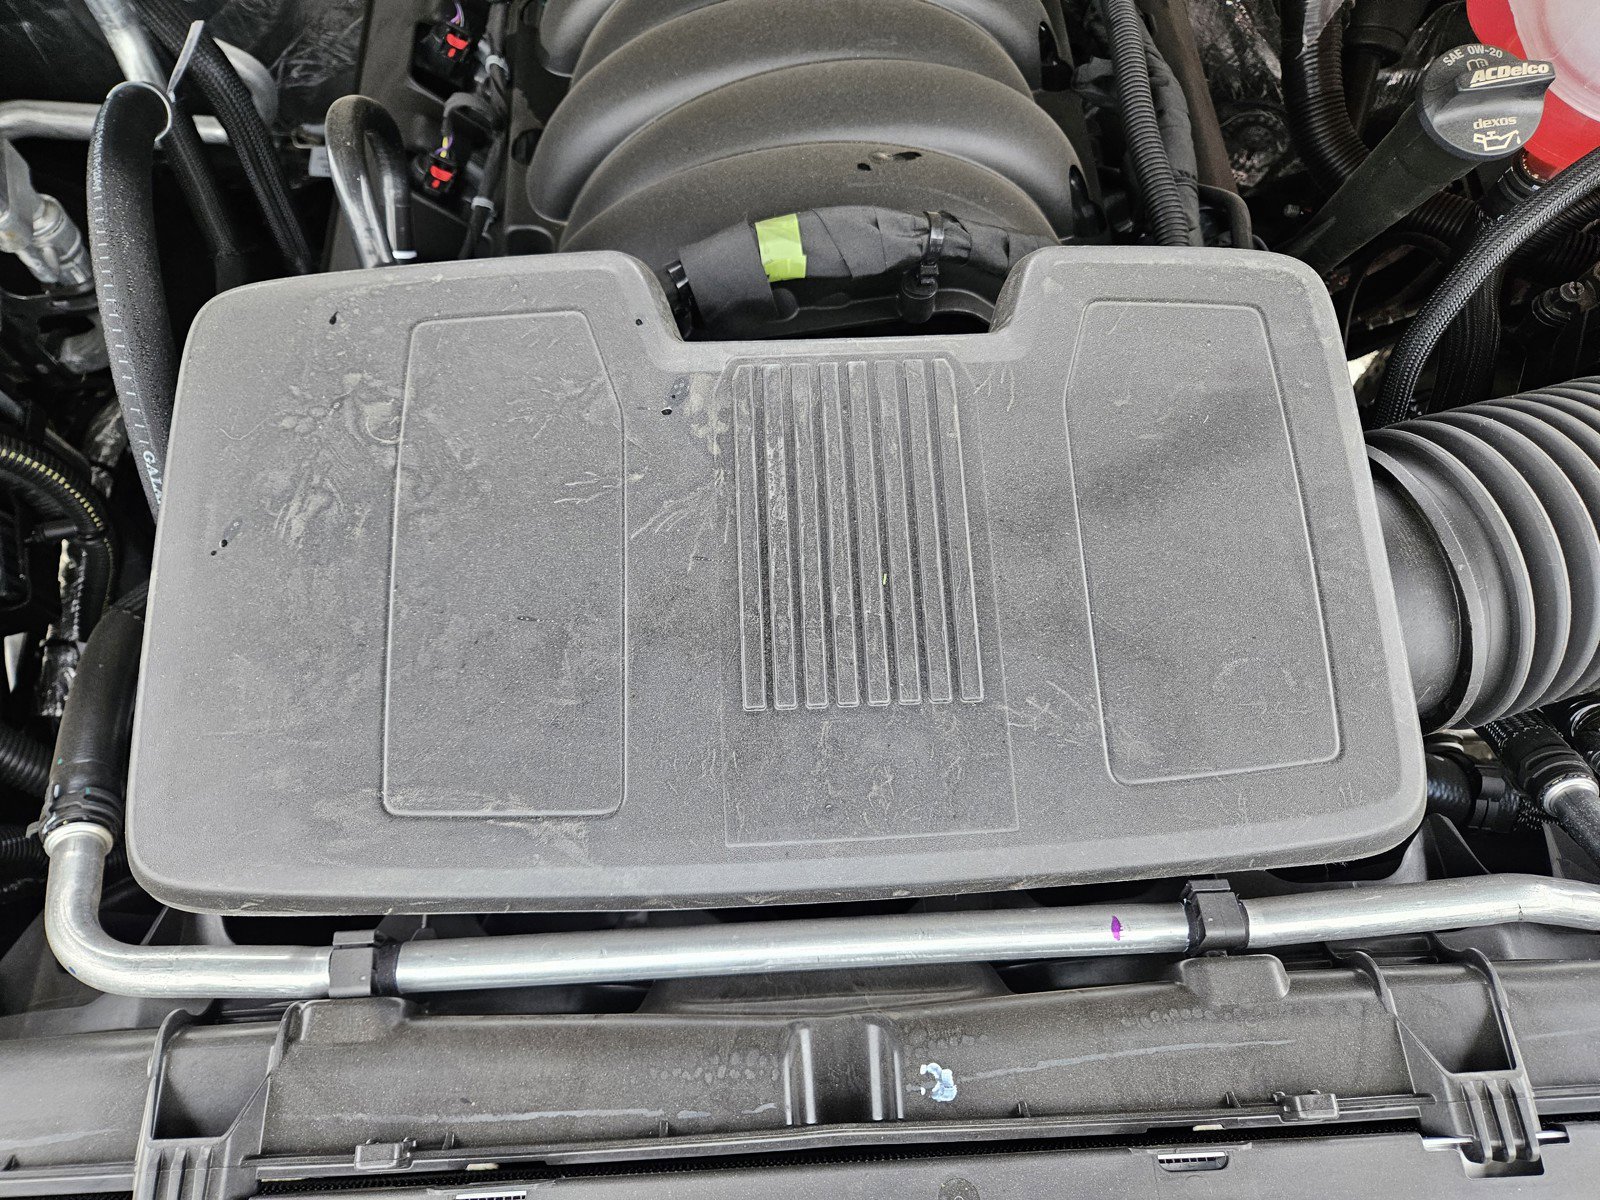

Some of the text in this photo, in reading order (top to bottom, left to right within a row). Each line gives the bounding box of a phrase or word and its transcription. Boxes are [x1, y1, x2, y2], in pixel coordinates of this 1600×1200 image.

[1442, 45, 1503, 67] SAE 0W-20
[1469, 62, 1550, 85] ACDelco
[1473, 116, 1518, 130] dexos
